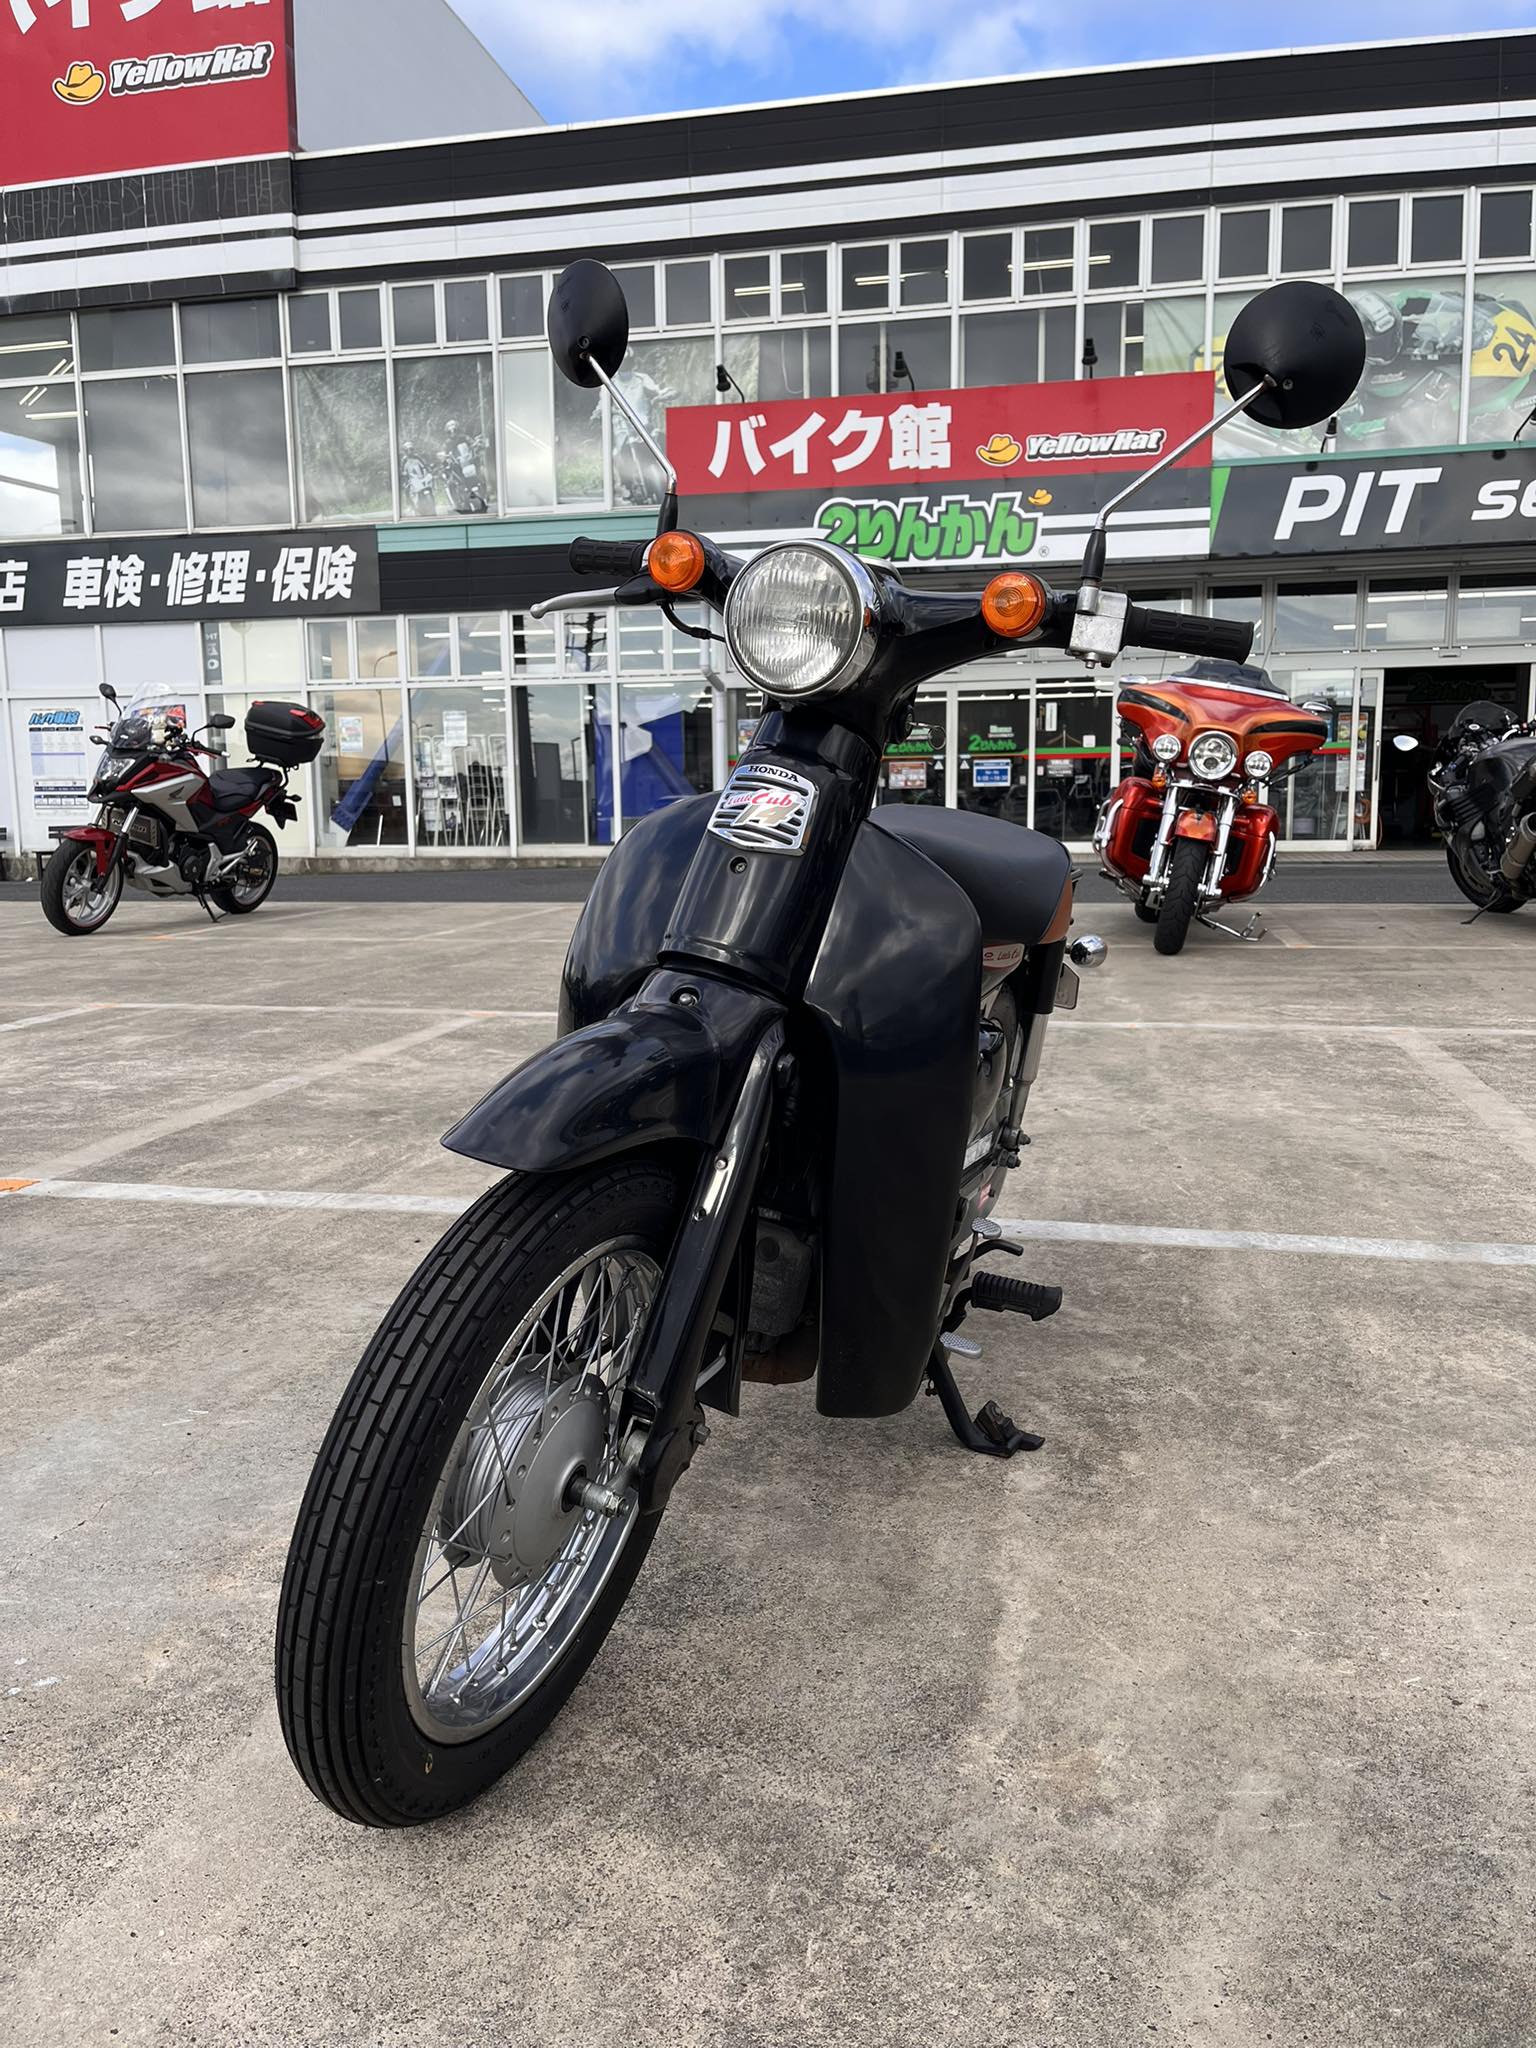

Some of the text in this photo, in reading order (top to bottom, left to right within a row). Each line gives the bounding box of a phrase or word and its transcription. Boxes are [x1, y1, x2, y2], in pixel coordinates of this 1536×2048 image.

[111, 43, 271, 93] YellowHat
[1493, 326, 1535, 372] 24
[708, 403, 952, 478] バイク館
[1026, 430, 1165, 459] YellowHat
[1273, 467, 1442, 540] PIT
[817, 497, 1038, 561] 2りんかん
[63, 545, 357, 610] 車検・修理・保険
[748, 765, 799, 783] HONDA
[751, 792, 794, 807] Cub
